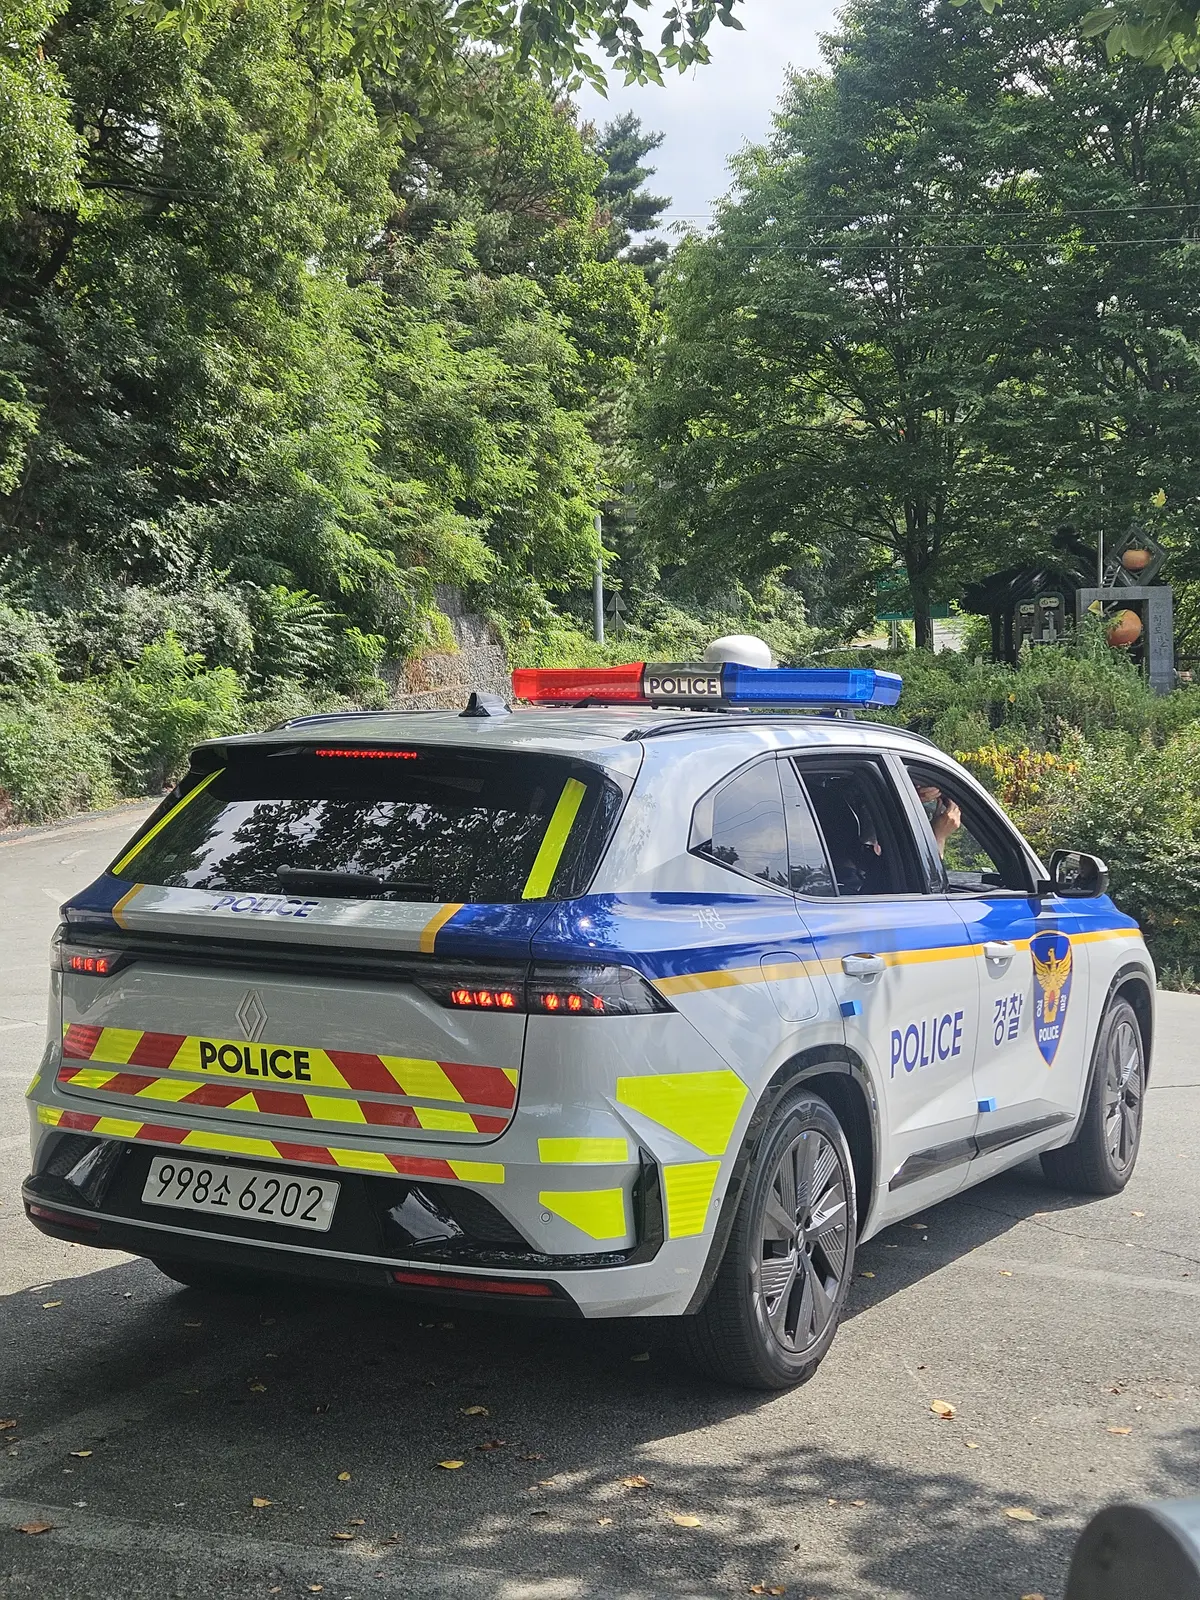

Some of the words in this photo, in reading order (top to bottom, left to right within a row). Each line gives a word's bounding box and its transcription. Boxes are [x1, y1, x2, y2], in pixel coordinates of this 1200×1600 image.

[649, 677, 718, 695] POLICE
[211, 895, 319, 918] POLICE
[992, 992, 1023, 1047] 경찰
[1038, 1025, 1060, 1043] POLICE
[199, 1041, 312, 1081] POLICE
[890, 1010, 964, 1080] POLICE
[156, 1164, 230, 1207] 998소
[238, 1176, 324, 1222] 6202
